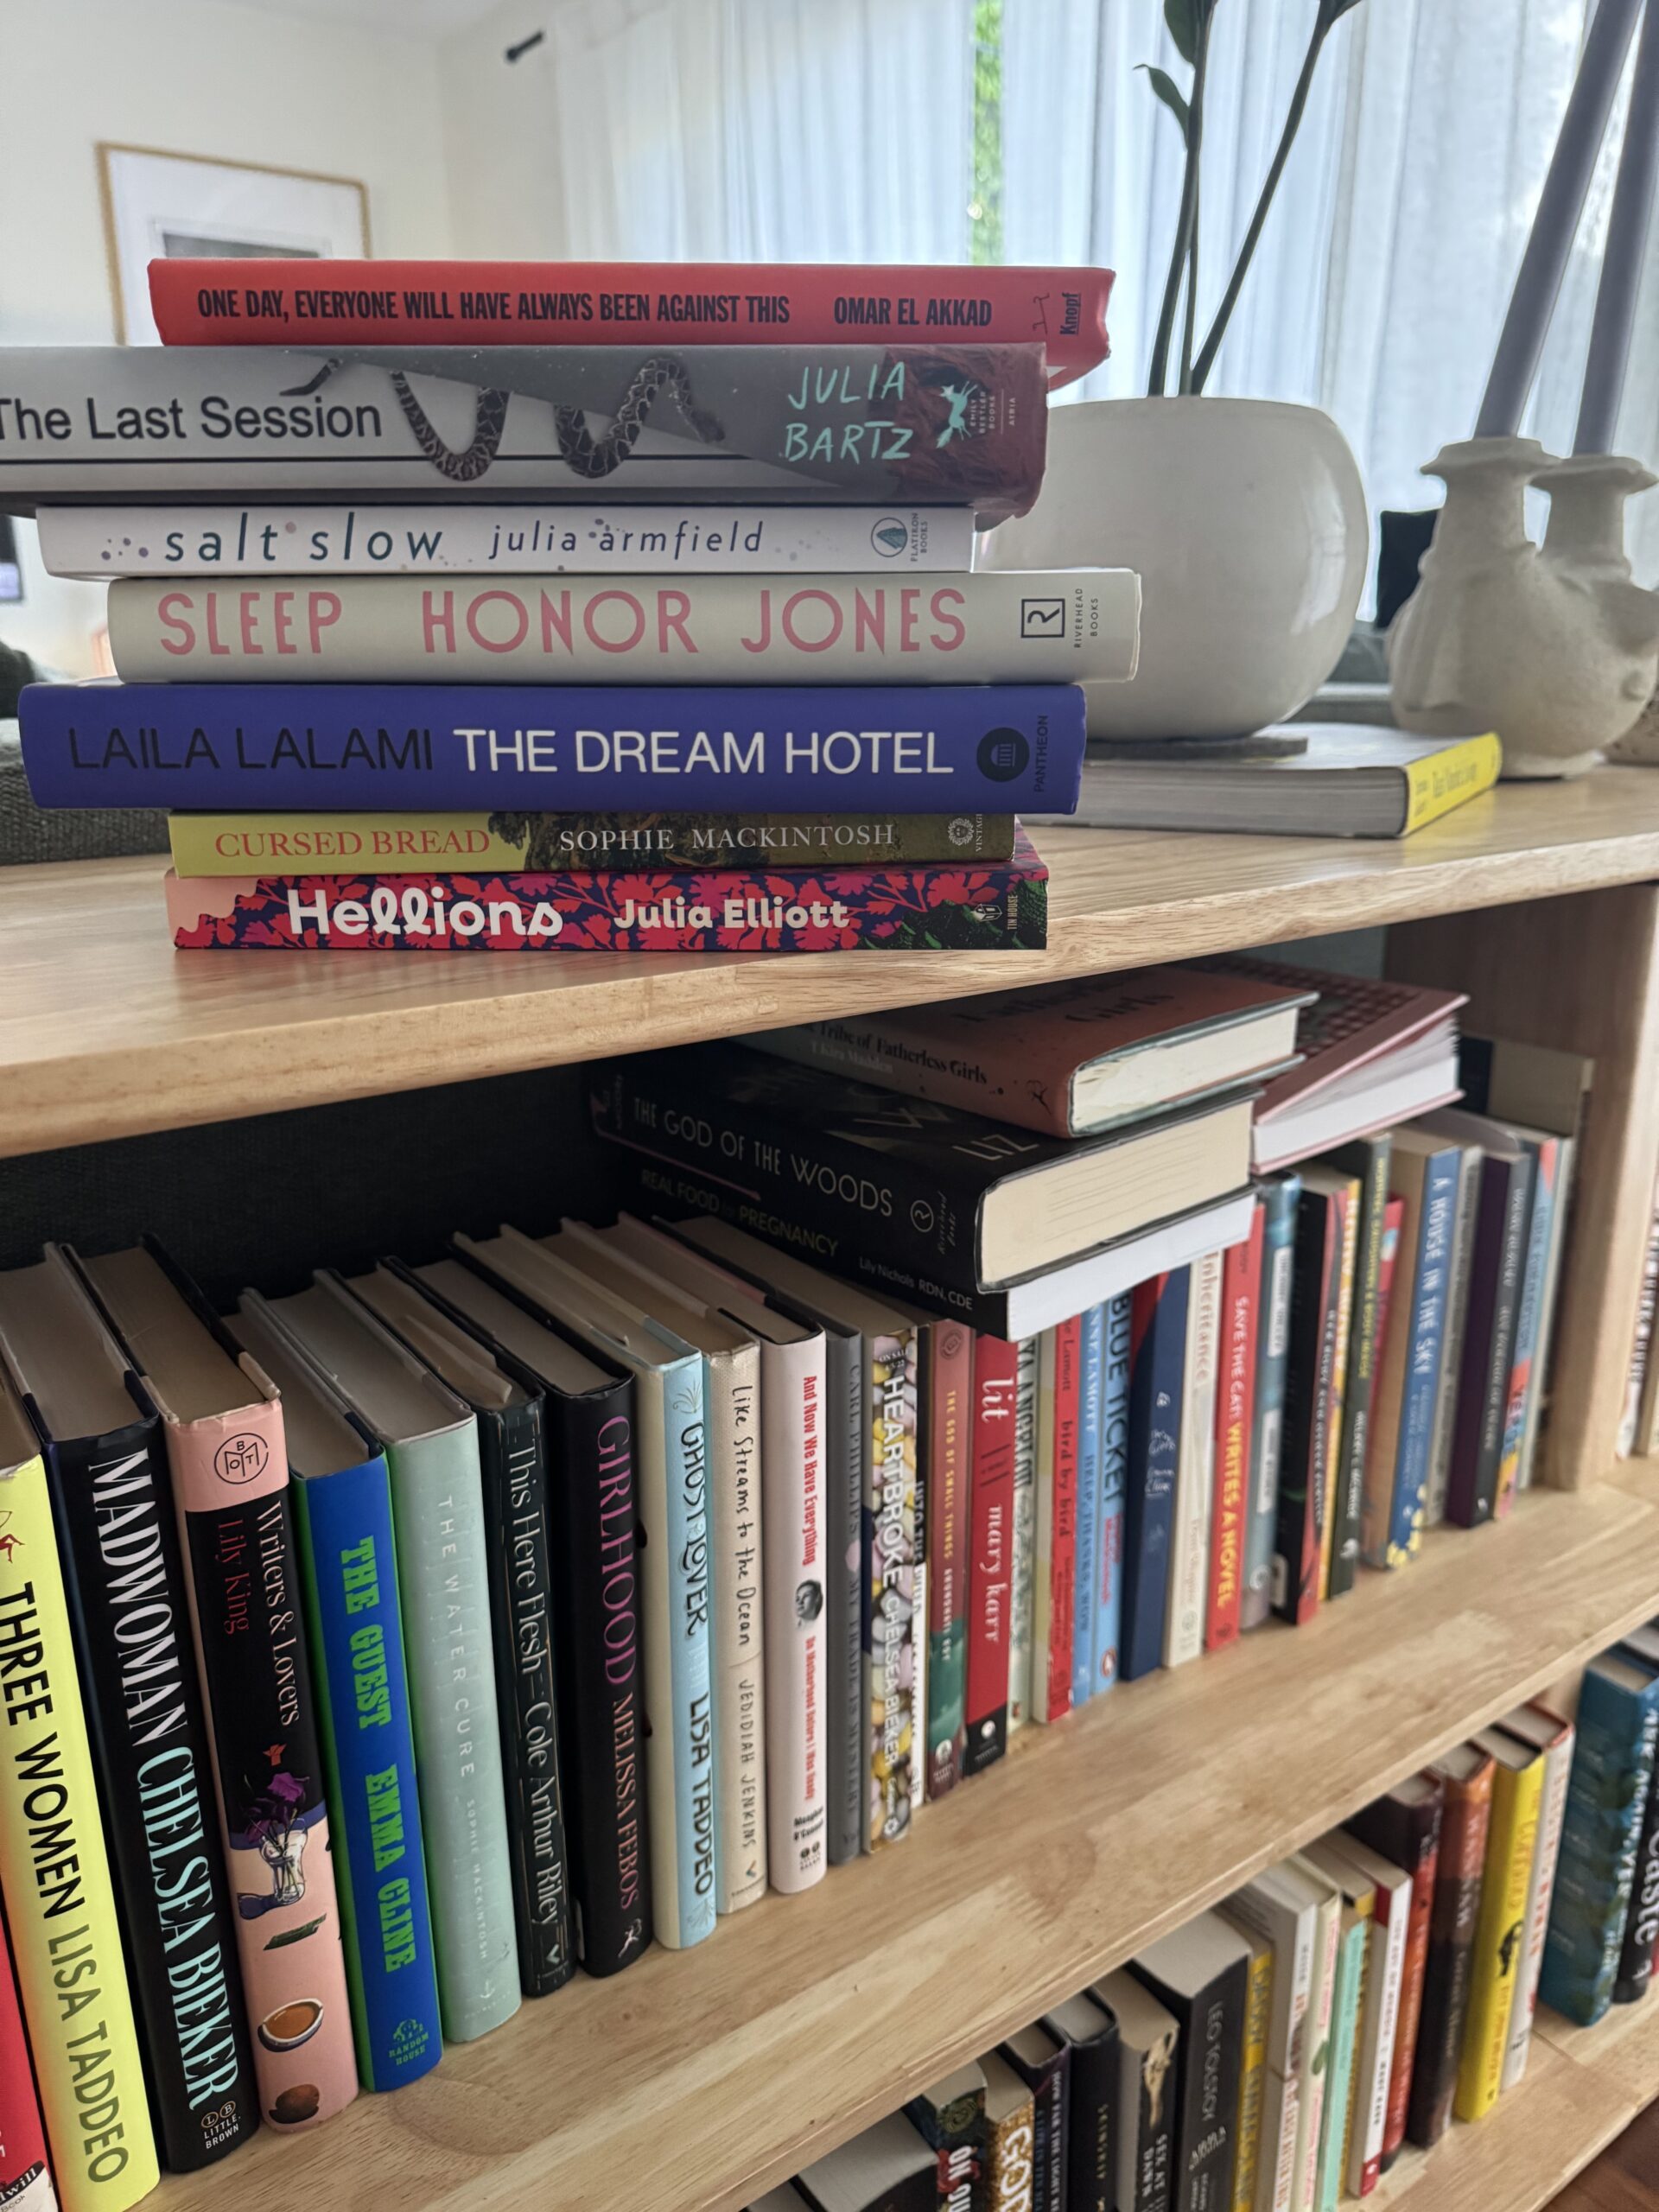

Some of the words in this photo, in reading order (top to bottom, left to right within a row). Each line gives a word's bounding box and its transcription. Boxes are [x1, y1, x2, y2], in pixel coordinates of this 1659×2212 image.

[199, 289, 238, 316] ONE
[246, 289, 289, 323] DAY,
[296, 290, 397, 319] EVERYONE
[405, 291, 454, 319] WILL
[461, 293, 512, 320] HAVE
[518, 293, 593, 321] ALWAYS
[601, 294, 650, 321] BEEN
[658, 295, 740, 321] AGAINST
[747, 296, 790, 322] THIS
[835, 297, 891, 325] OMAR
[898, 298, 919, 325] EL
[927, 299, 992, 327] AKKAD
[1060, 292, 1082, 335] Knopf
[787, 361, 905, 410] JULIA
[969, 397, 978, 427] EMILY
[0, 400, 71, 441] The
[87, 397, 184, 440] Last
[200, 397, 381, 438] Session
[785, 422, 913, 463] BARTZ
[165, 512, 277, 561] salt
[310, 512, 442, 561] slow
[489, 521, 576, 559] julia
[600, 521, 763, 559] armfield
[920, 519, 929, 554] BOOKS
[157, 592, 341, 655] SLEEP
[422, 588, 698, 656] HONOR
[741, 587, 965, 656] JONES
[1074, 587, 1083, 648] RIVERHEAD
[69, 728, 220, 771] LAILA
[236, 728, 432, 771] LALAMI
[454, 728, 557, 772] THE
[575, 731, 764, 773] DREAM
[785, 731, 954, 773] HOTEL
[1034, 715, 1048, 791] PANTHEON
[215, 830, 362, 858] CURSED
[372, 830, 489, 855] BREAD
[560, 830, 674, 852] SOPHIE
[692, 824, 894, 850] MACKINTOSH
[287, 887, 563, 937] Hellions
[614, 899, 714, 930] Julia
[723, 899, 849, 930] Elliott
[1007, 894, 1018, 918] HOUSE
[1007, 918, 1018, 931] TIN
[820, 1023, 855, 1045] Tribe
[858, 1033, 871, 1046] of
[877, 1035, 947, 1072] Fatherless
[950, 1061, 987, 1084] Girls
[633, 1097, 657, 1128] THE
[664, 1109, 712, 1147] GOD
[721, 1131, 745, 1161] OF
[753, 1141, 781, 1176] THE
[791, 1154, 893, 1217] WOODS
[1433, 1178, 1452, 1191] A
[641, 1169, 675, 1197] REAL
[677, 1181, 720, 1212] FOOD
[739, 1205, 838, 1258] PREGNANCY
[858, 1256, 876, 1275] Lily
[878, 1262, 914, 1291] Nichols
[918, 1278, 946, 1304] RDN,
[947, 1290, 973, 1311] CDE
[1425, 1197, 1448, 1262] HOUSE
[1422, 1268, 1440, 1291] IN
[1107, 1294, 1129, 1381] BLUE
[1195, 1251, 1219, 1380] Inheritance
[1234, 1296, 1249, 1343] SAVE
[1417, 1296, 1439, 1333] THE
[803, 1376, 817, 1398] And
[1062, 1339, 1074, 1391] Lamott
[1231, 1343, 1247, 1377] THE
[1413, 1337, 1436, 1375] SKY
[732, 1385, 753, 1427] Like
[803, 1400, 817, 1433] Now
[945, 1420, 956, 1442] GOD
[946, 1390, 957, 1413] THE
[982, 1377, 1014, 1425] lit
[804, 1434, 817, 1456] We
[945, 1449, 955, 1464] OF
[1060, 1420, 1073, 1461] bird
[1103, 1395, 1127, 1502] TICKET
[1224, 1422, 1243, 1507] WRITES
[509, 1438, 537, 1509] This
[681, 1421, 707, 1525] GHOST
[734, 1437, 753, 1515] Streams
[804, 1459, 818, 1493] Have
[849, 1433, 861, 1534] PHILLIPS
[881, 1377, 905, 1588] HEARTBROKE
[944, 1471, 955, 1508] SMALL
[1061, 1469, 1071, 1491] by
[218, 1518, 251, 1564] Lily
[438, 1495, 457, 1557] THE
[737, 1522, 753, 1538] to
[803, 1497, 818, 1567] Everything
[943, 1513, 954, 1559] THINGS
[980, 1504, 1002, 1573] mary
[1058, 1499, 1071, 1537] bird
[1221, 1512, 1237, 1527] A
[257, 1500, 286, 1609] Writers
[340, 1535, 379, 1614] THE
[512, 1510, 541, 1590] Here
[596, 1414, 637, 1686] GIRLHOOD
[736, 1547, 755, 1580] the
[1217, 1531, 1236, 1608] NOVEL
[88, 1447, 188, 1747] MADWOMAN
[224, 1572, 250, 1635] King
[679, 1540, 709, 1637] LOVER
[737, 1587, 756, 1646] Ocean
[985, 1582, 1008, 1643] karr
[0, 1580, 54, 1726] THREE
[270, 1611, 295, 1635] &
[442, 1574, 467, 1682] WATER
[517, 1592, 548, 1675] Flesh
[885, 1595, 900, 1690] CHELSEA
[270, 1637, 300, 1726] Lovers
[350, 1624, 391, 1729] GUEST
[454, 1697, 474, 1777] CURE
[524, 1701, 553, 1770] Cole
[690, 1693, 710, 1767] LISA
[739, 1678, 756, 1764] JEDIDIAH
[884, 1696, 899, 1766] BIEKER
[613, 1692, 636, 1821] MELISSA
[15, 1731, 86, 1919] WOMEN
[365, 1763, 406, 1873] EMMA
[530, 1776, 558, 1859] Arthur
[691, 1768, 714, 1896] TADDEO
[740, 1774, 756, 1849] JENKINS
[137, 1745, 216, 1955] CHELSEA
[618, 1819, 639, 1910] FEBOS
[531, 1861, 563, 1926] Riley
[378, 1877, 416, 1974] CLINE
[48, 1923, 102, 2021] LISA
[168, 1941, 238, 2111] BIEKER
[388, 2032, 429, 2058] RANDOM
[395, 2044, 426, 2066] HOUSE
[67, 2020, 129, 2183] TADDEO
[206, 2123, 239, 2149] BROWN
[948, 2145, 972, 2181] ON
[1155, 2134, 1167, 2167] SEX
